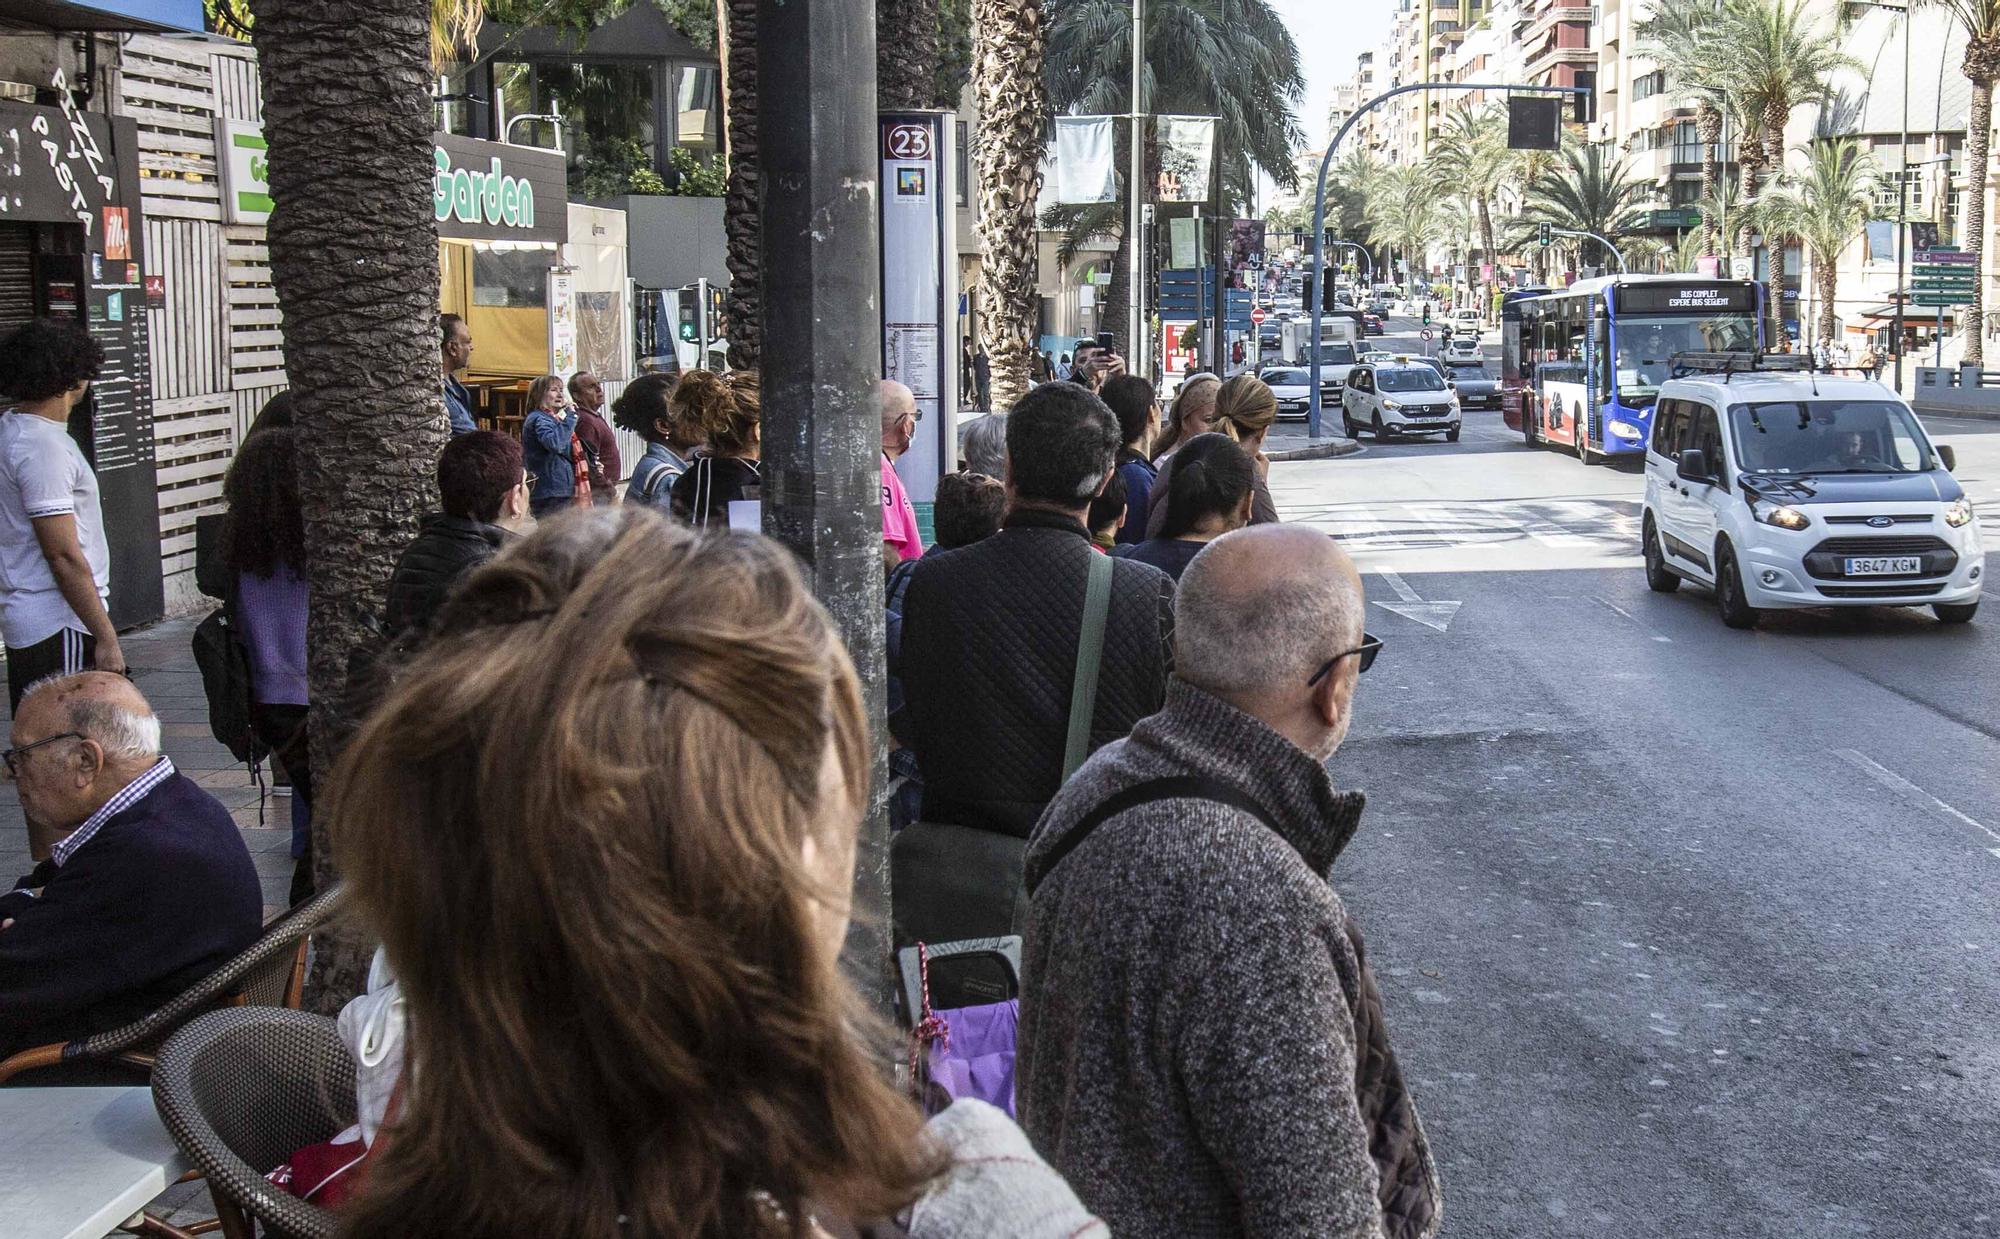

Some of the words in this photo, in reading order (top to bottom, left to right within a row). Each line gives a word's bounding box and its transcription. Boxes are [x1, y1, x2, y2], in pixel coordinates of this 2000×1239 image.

[894, 130, 926, 154] 23
[31, 115, 94, 236] PASTA
[433, 146, 534, 228] Garden
[106, 214, 128, 254] illy
[1669, 298, 1691, 307] ESPERE
[1691, 298, 1703, 306] BUS
[1680, 290, 1692, 298] BUS
[1693, 289, 1718, 298] COMPLET
[1854, 560, 1887, 573] 3647
